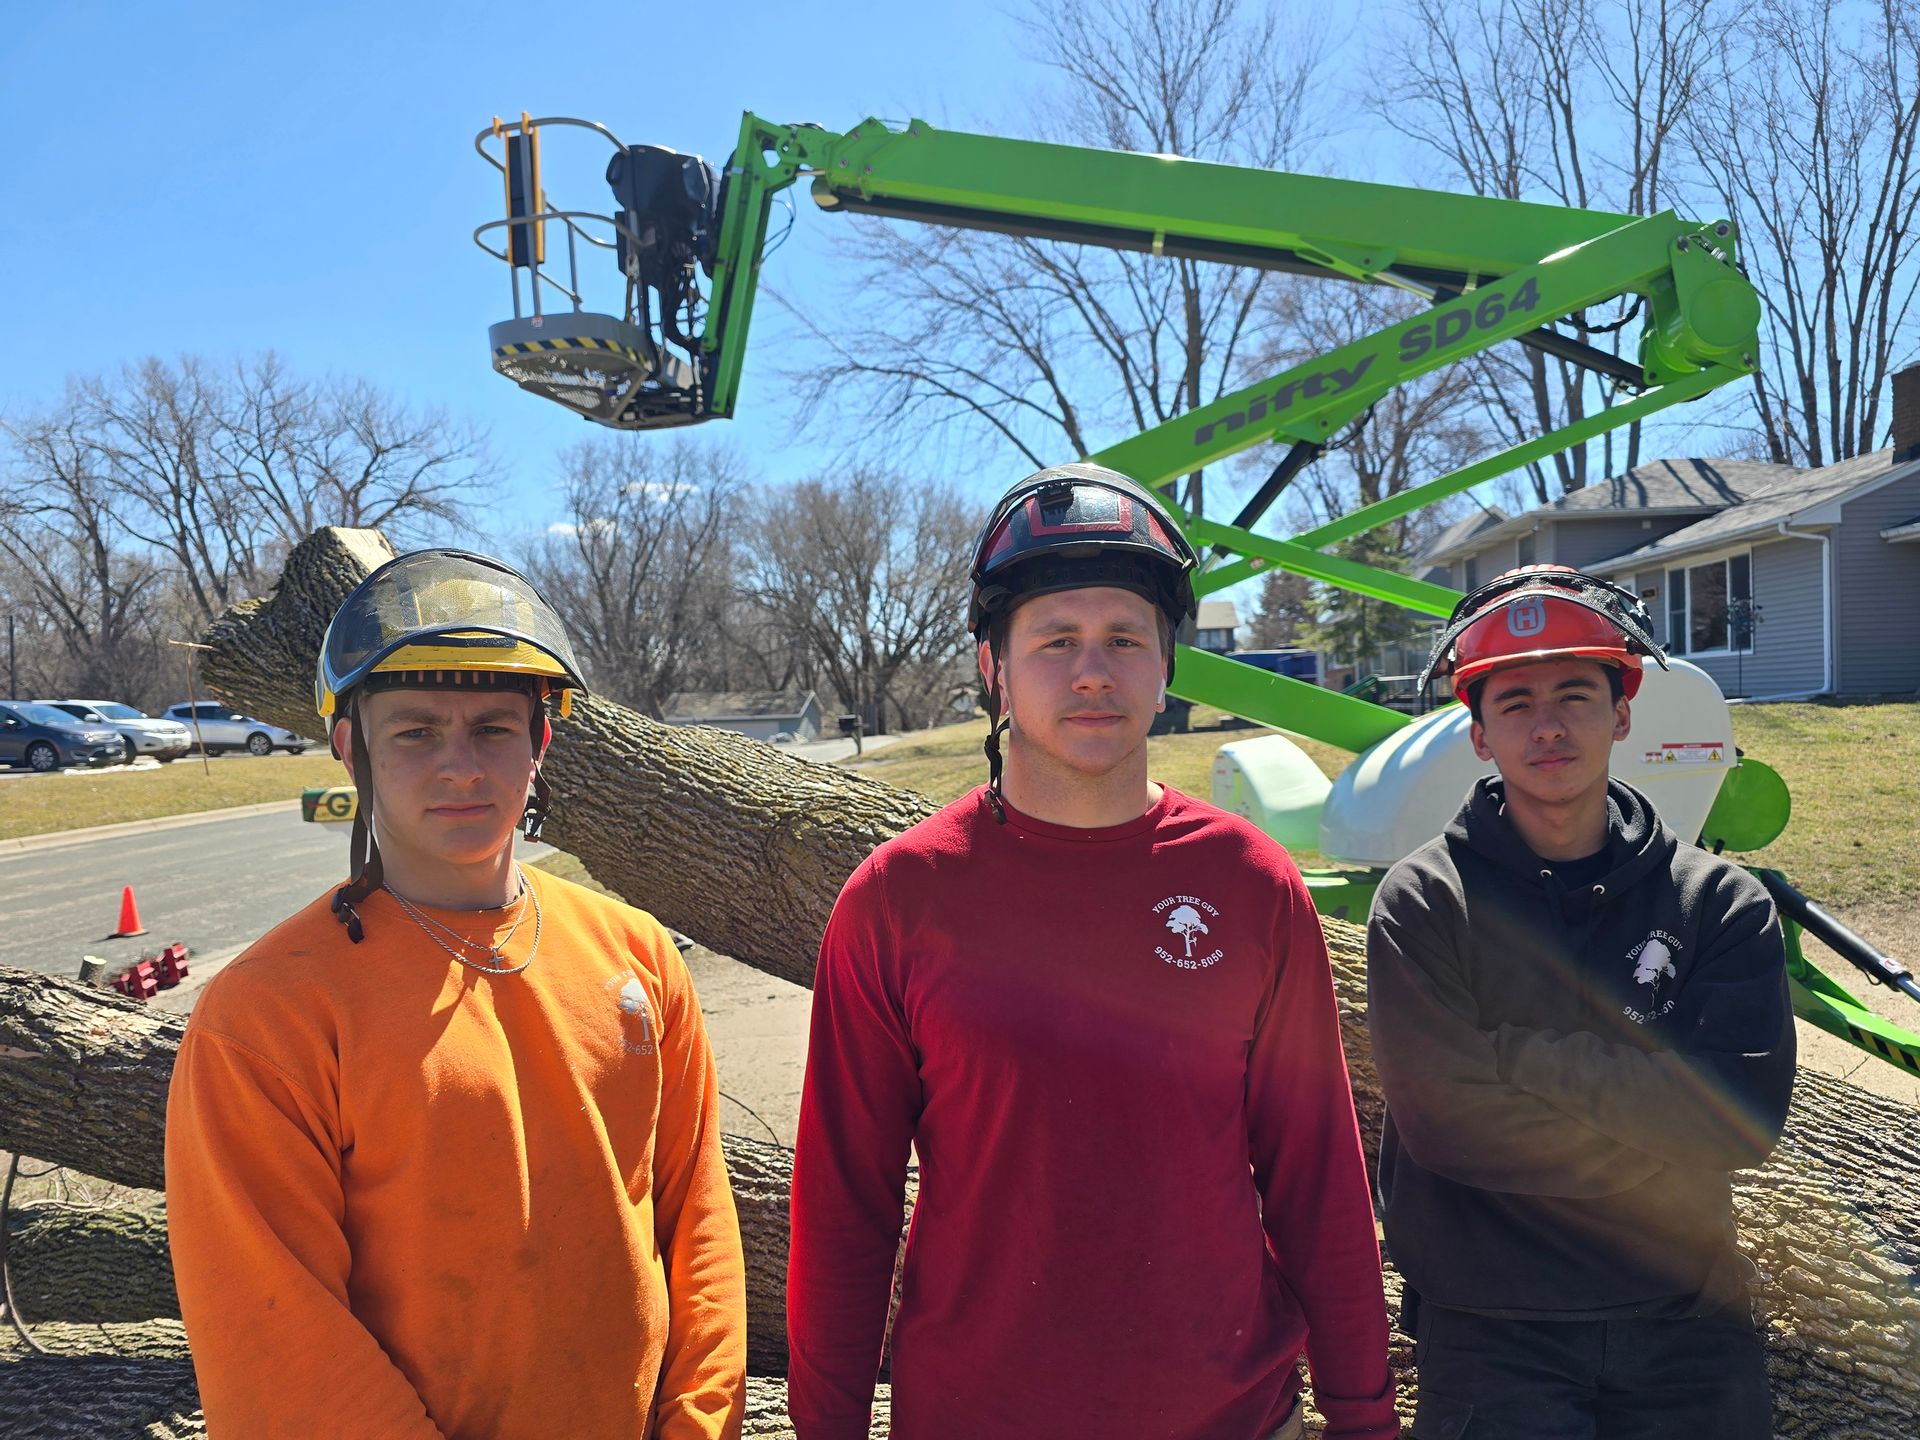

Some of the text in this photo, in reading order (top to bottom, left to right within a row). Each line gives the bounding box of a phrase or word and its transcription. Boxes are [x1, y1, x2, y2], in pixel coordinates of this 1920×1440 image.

[1194, 276, 1541, 446] nifty SD64
[327, 793, 352, 817] G
[1152, 895, 1219, 917] YOUR TREE GUY
[1667, 935, 1683, 951] GUY
[1154, 946, 1224, 969] 952-652-5050
